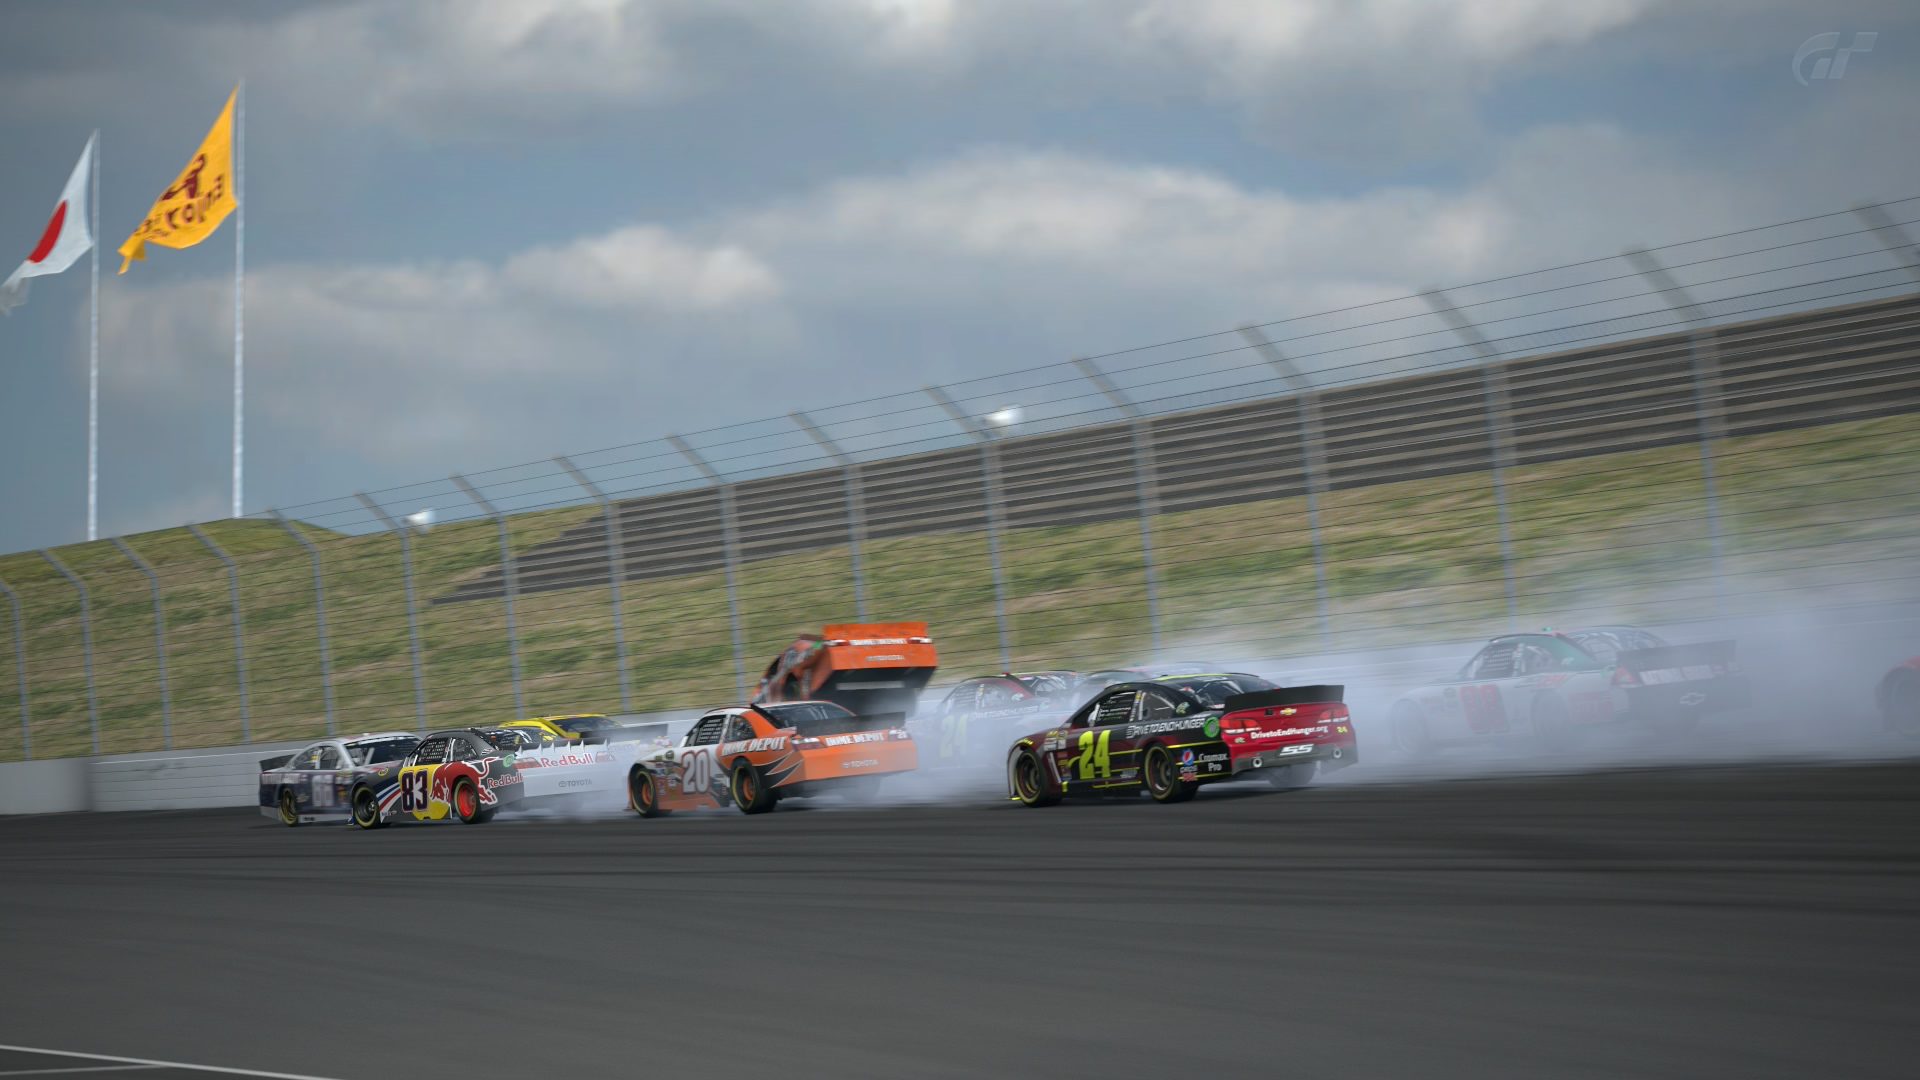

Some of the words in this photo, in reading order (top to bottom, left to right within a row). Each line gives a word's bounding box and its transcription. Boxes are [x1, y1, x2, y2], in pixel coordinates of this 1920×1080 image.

[748, 736, 789, 753] DEPOT
[1078, 729, 1111, 780] 24
[1279, 744, 1315, 756] SS
[682, 748, 711, 795] 20
[1208, 762, 1222, 772] Pro
[401, 769, 428, 813] 83
